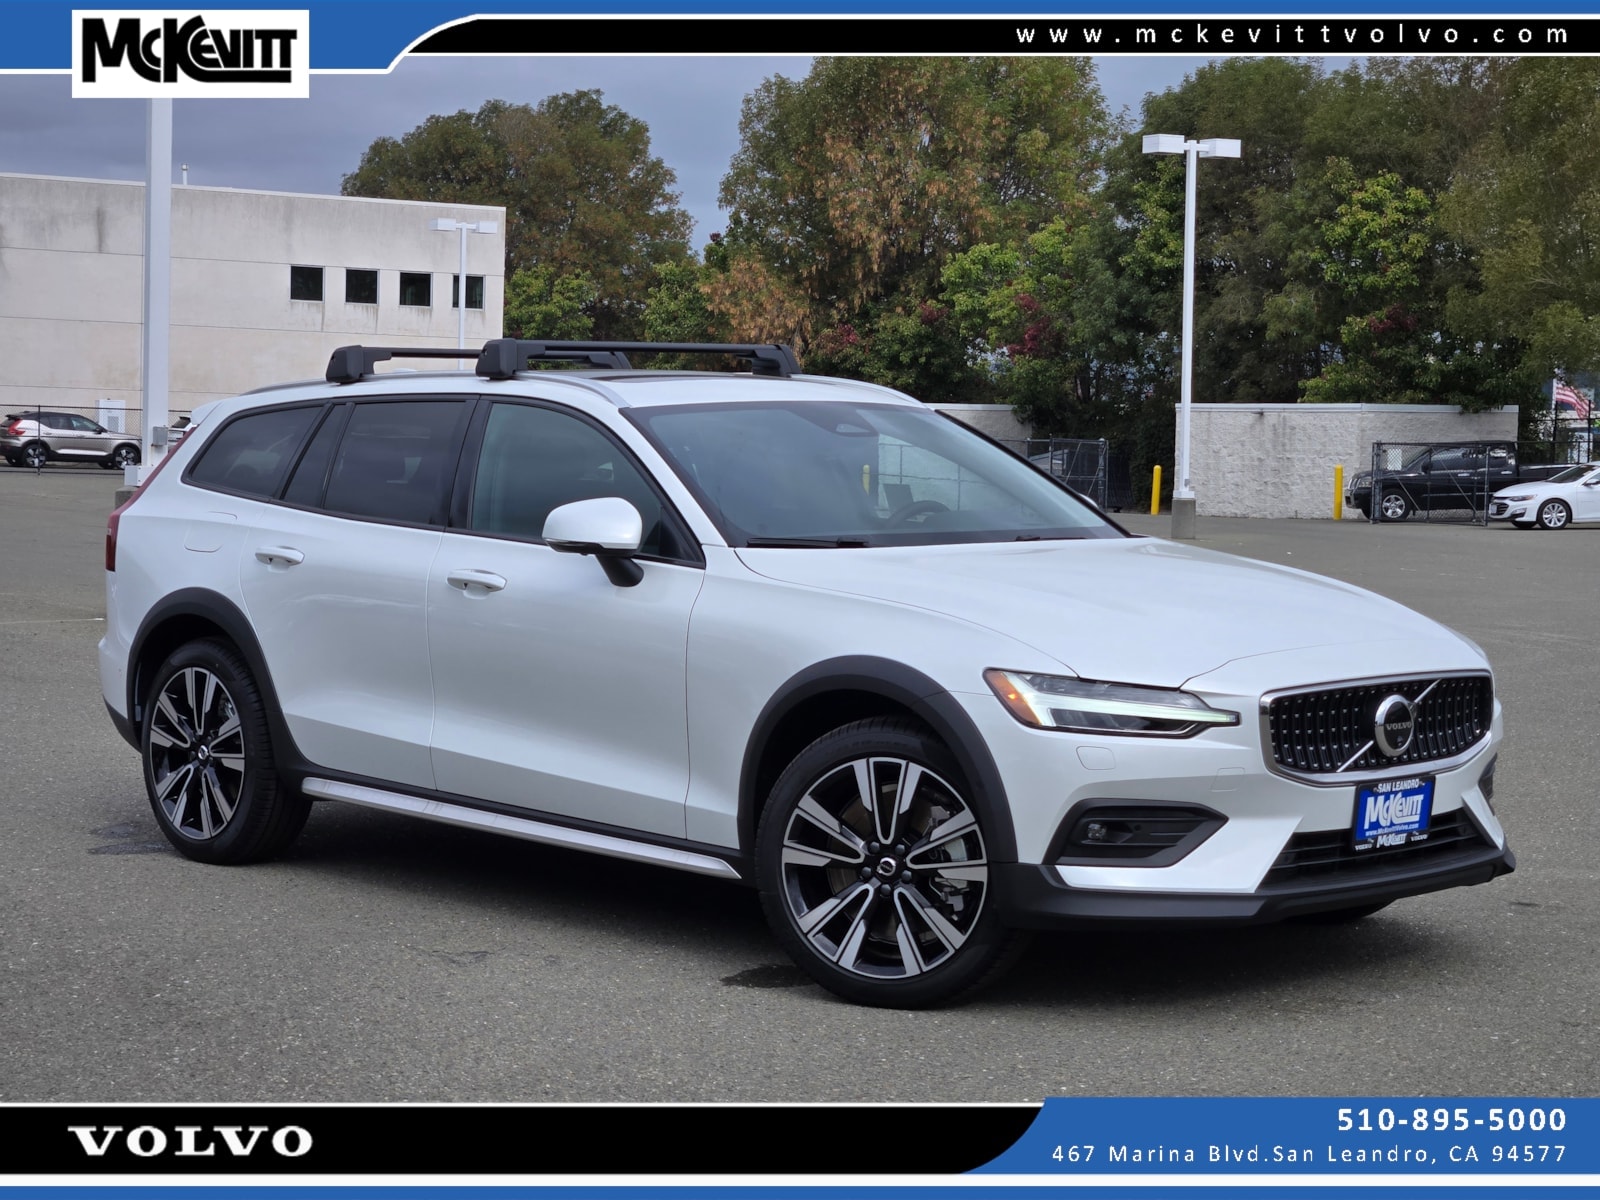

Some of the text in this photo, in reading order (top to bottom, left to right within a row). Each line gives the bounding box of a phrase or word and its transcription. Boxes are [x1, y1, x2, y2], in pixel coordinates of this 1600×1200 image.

[1385, 721, 1412, 730] VOLVO
[1377, 779, 1420, 793] SAN LEANDRO
